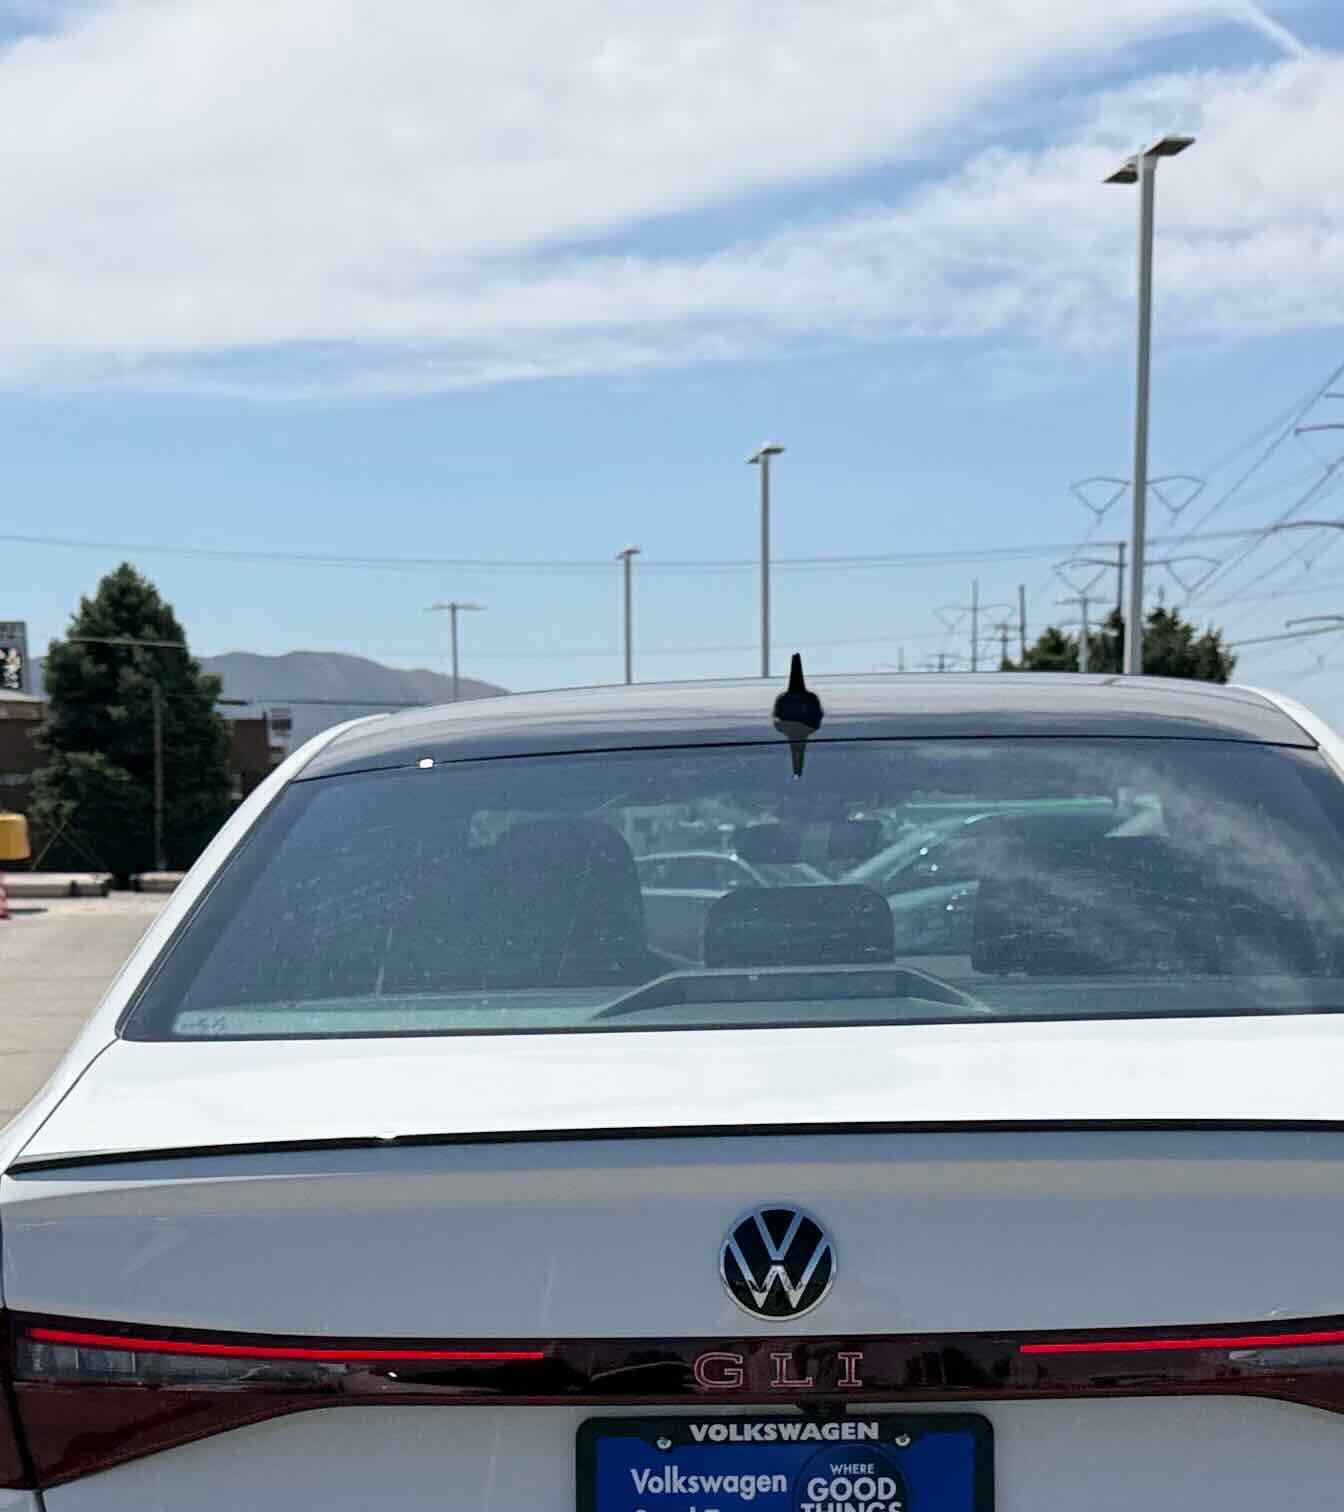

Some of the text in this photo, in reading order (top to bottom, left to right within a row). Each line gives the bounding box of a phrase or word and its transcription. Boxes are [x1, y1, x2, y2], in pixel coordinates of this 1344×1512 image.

[693, 1351, 864, 1389] GLI
[689, 1422, 880, 1442] VOLKSWAGEN
[830, 1463, 875, 1475] WHERE
[630, 1466, 787, 1500] Volkswagen
[806, 1477, 897, 1502] GOOD
